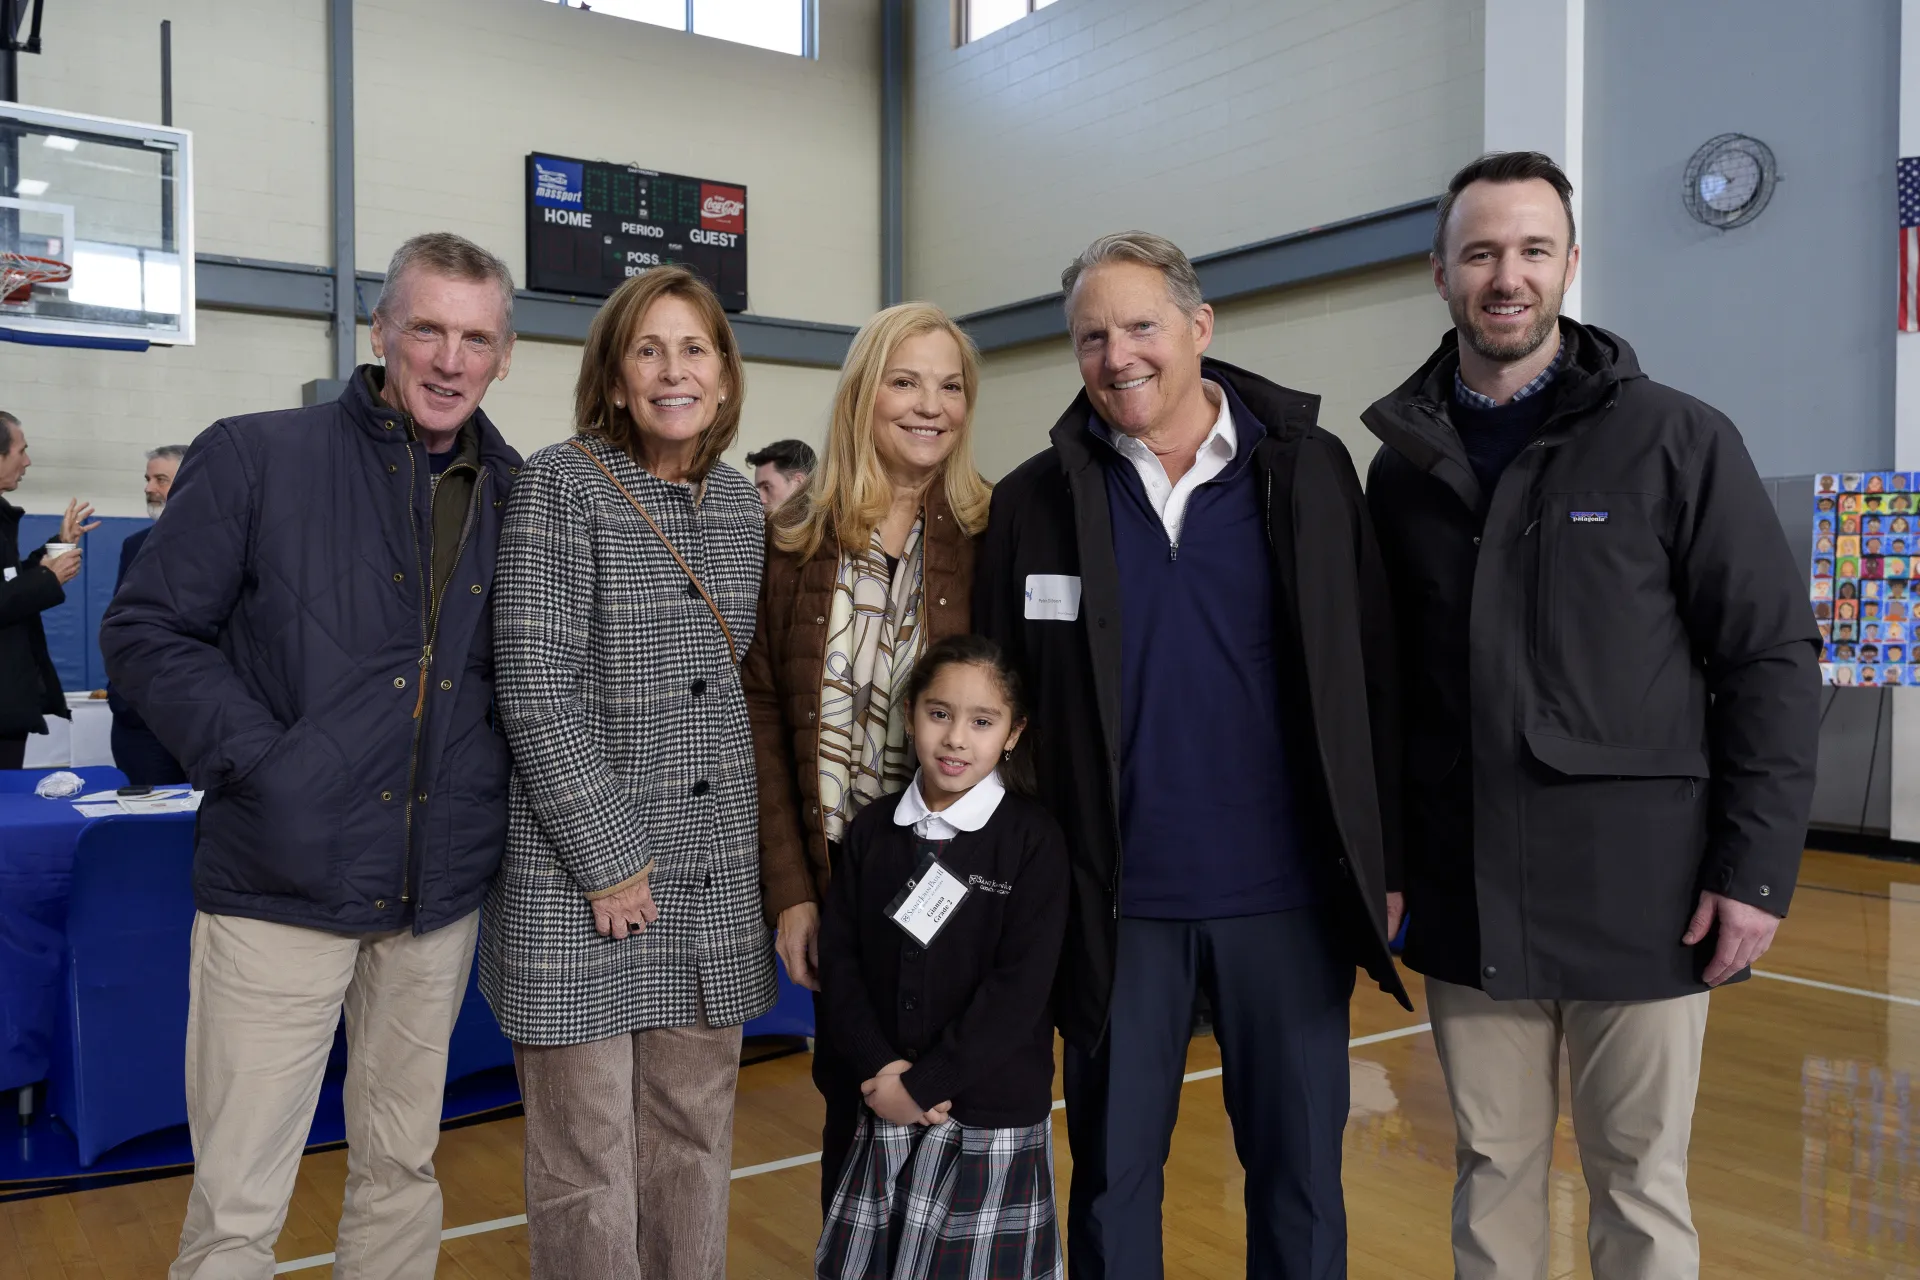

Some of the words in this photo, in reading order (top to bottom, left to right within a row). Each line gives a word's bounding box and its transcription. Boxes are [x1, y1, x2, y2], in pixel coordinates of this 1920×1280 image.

[535, 187, 582, 203] massport
[544, 208, 592, 228] HOME
[621, 221, 664, 238] PERIOD
[689, 228, 738, 248] GUEST
[627, 251, 662, 265] POSS.
[926, 896, 946, 918] Gianna
[933, 903, 951, 923] Grade
